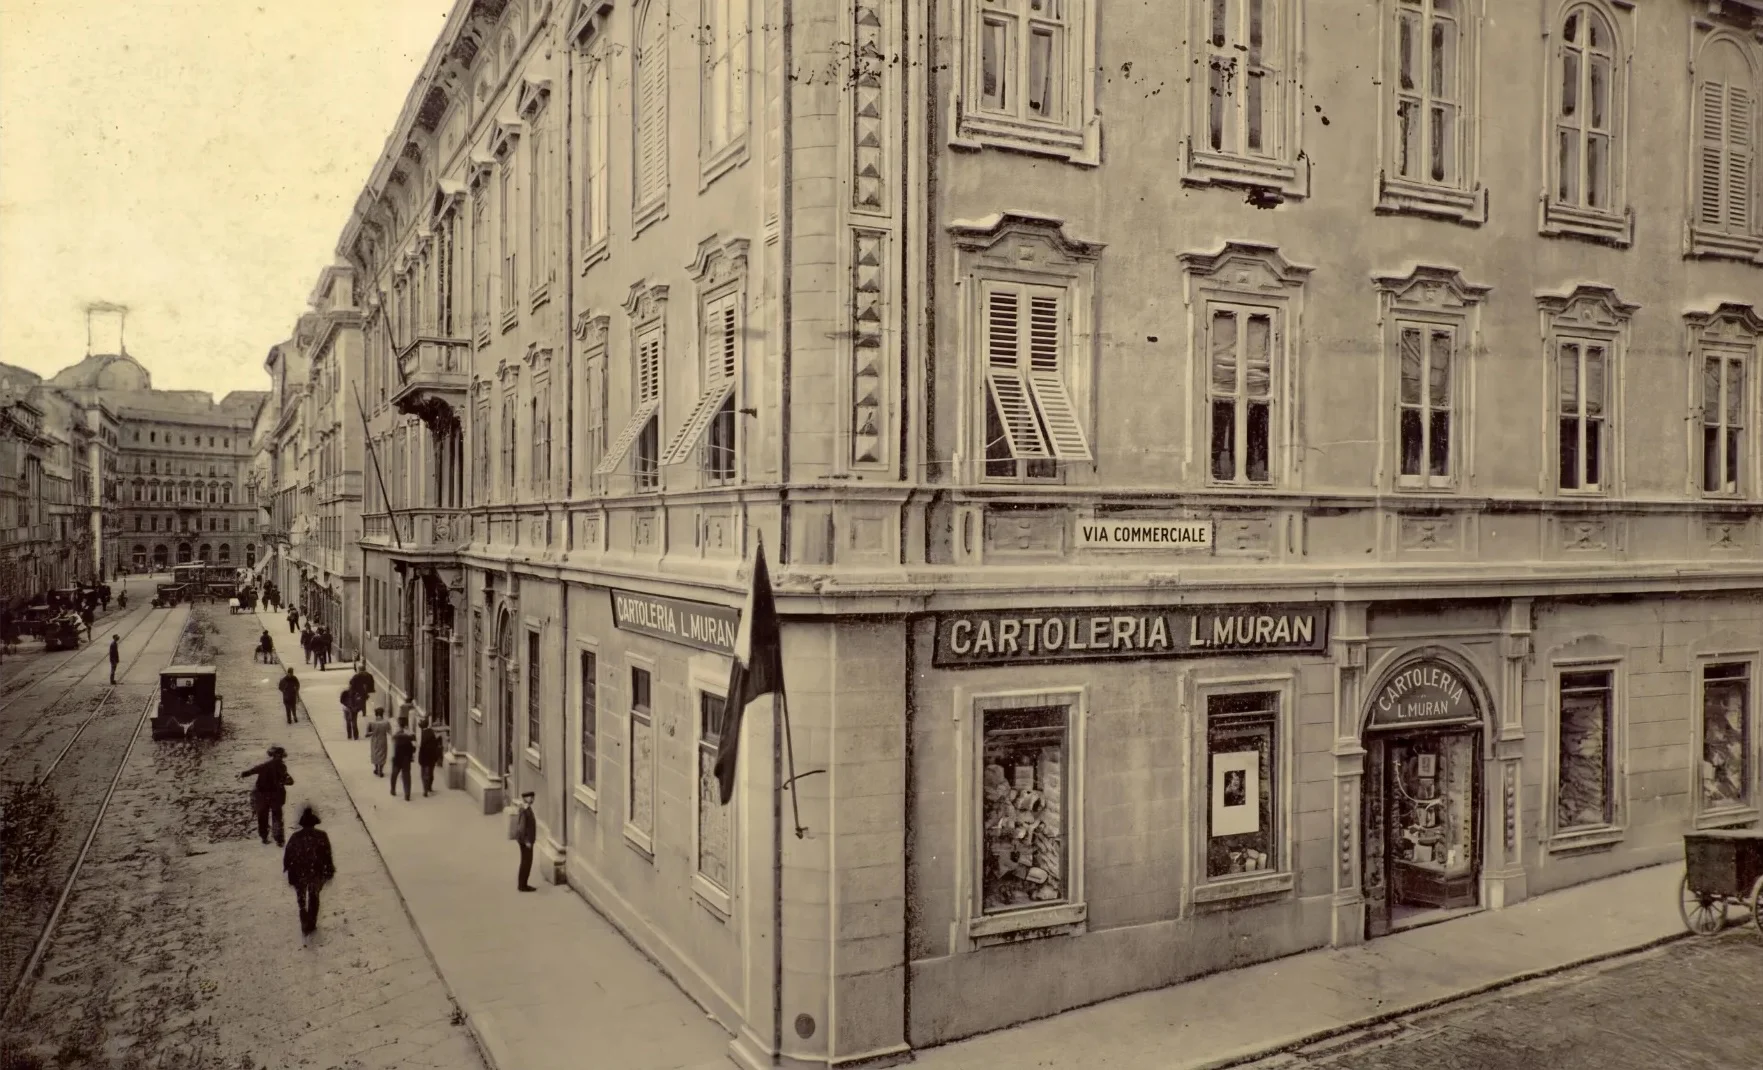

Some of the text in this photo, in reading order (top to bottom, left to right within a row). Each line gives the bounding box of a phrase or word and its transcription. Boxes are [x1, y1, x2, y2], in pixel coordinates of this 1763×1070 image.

[1083, 526, 1206, 543] VIA COMMERCIALE
[617, 597, 676, 634] CARTOLERIA
[951, 616, 1168, 654] CARTOLERIA
[1380, 668, 1463, 711] CARTOLERIA
